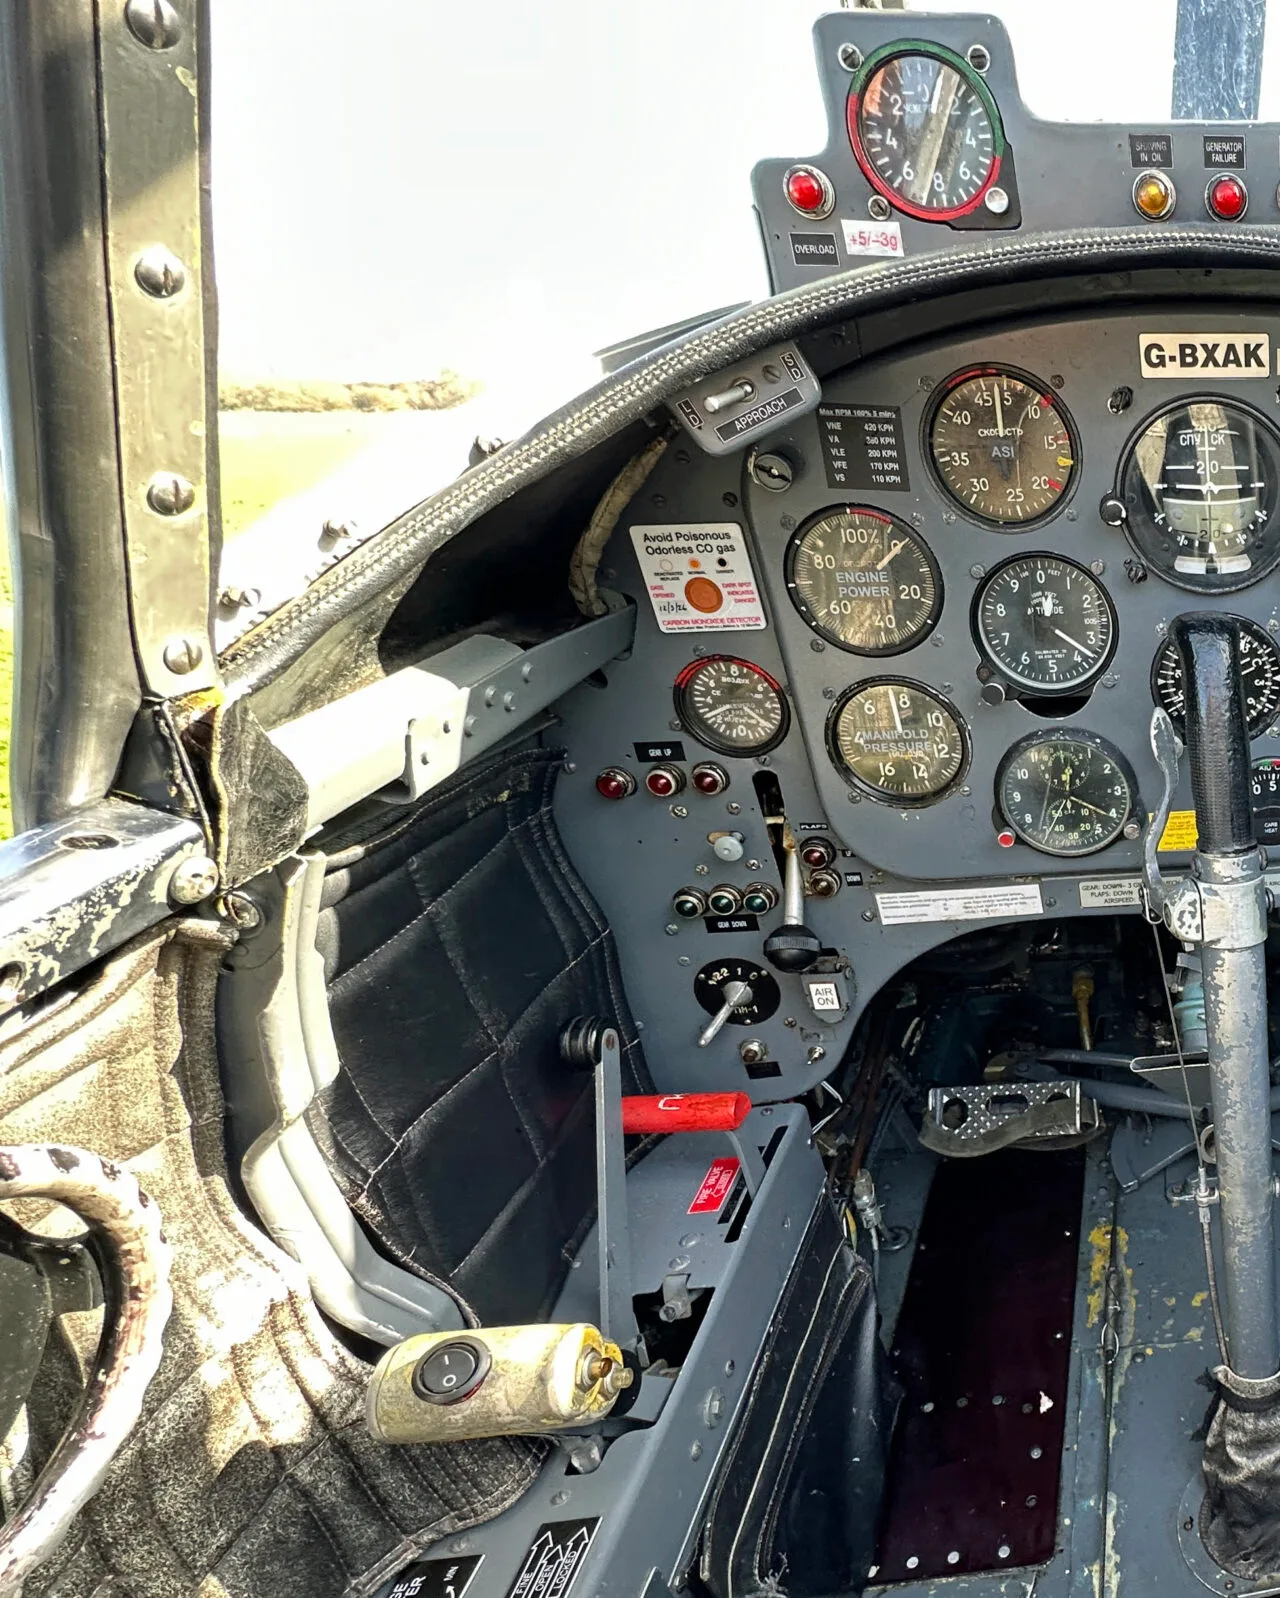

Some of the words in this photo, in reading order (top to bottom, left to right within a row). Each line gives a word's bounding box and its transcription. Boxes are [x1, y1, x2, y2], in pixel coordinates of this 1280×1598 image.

[1206, 143, 1242, 151] GENERATOR
[1141, 153, 1147, 162] IN
[1152, 153, 1163, 162] OIL
[1212, 154, 1237, 162] FAILURE
[795, 245, 835, 254] OVERLOAD
[1144, 343, 1265, 368] G-BXAK
[735, 398, 787, 431] APPROACH
[826, 422, 841, 430] VNE
[864, 423, 876, 431] 420
[878, 424, 893, 432] KPH
[880, 437, 895, 445] KPH
[831, 448, 845, 456] VLE
[992, 446, 1015, 458] ASI
[833, 461, 847, 469] VFE
[643, 533, 672, 542] Avoid
[675, 532, 731, 542] Poisonous
[645, 546, 693, 555] Odorless
[696, 544, 713, 553] CO
[716, 545, 735, 554] gas
[814, 554, 835, 569] 80
[836, 572, 888, 582] ENGINE
[839, 587, 890, 597] POWER
[900, 585, 920, 599] 20
[830, 600, 851, 614] 60
[862, 730, 928, 740] MANIFOLD
[863, 742, 932, 752] PRESSURE
[934, 744, 949, 758] 12
[879, 762, 895, 776] 16
[815, 987, 833, 996] AIR
[817, 998, 834, 1006] ON
[706, 1166, 724, 1188] VALVE
[444, 1566, 459, 1582] MIN
[554, 1552, 576, 1588] LOCKED
[516, 1572, 533, 1594] FINE
[534, 1564, 553, 1592] OPEN
